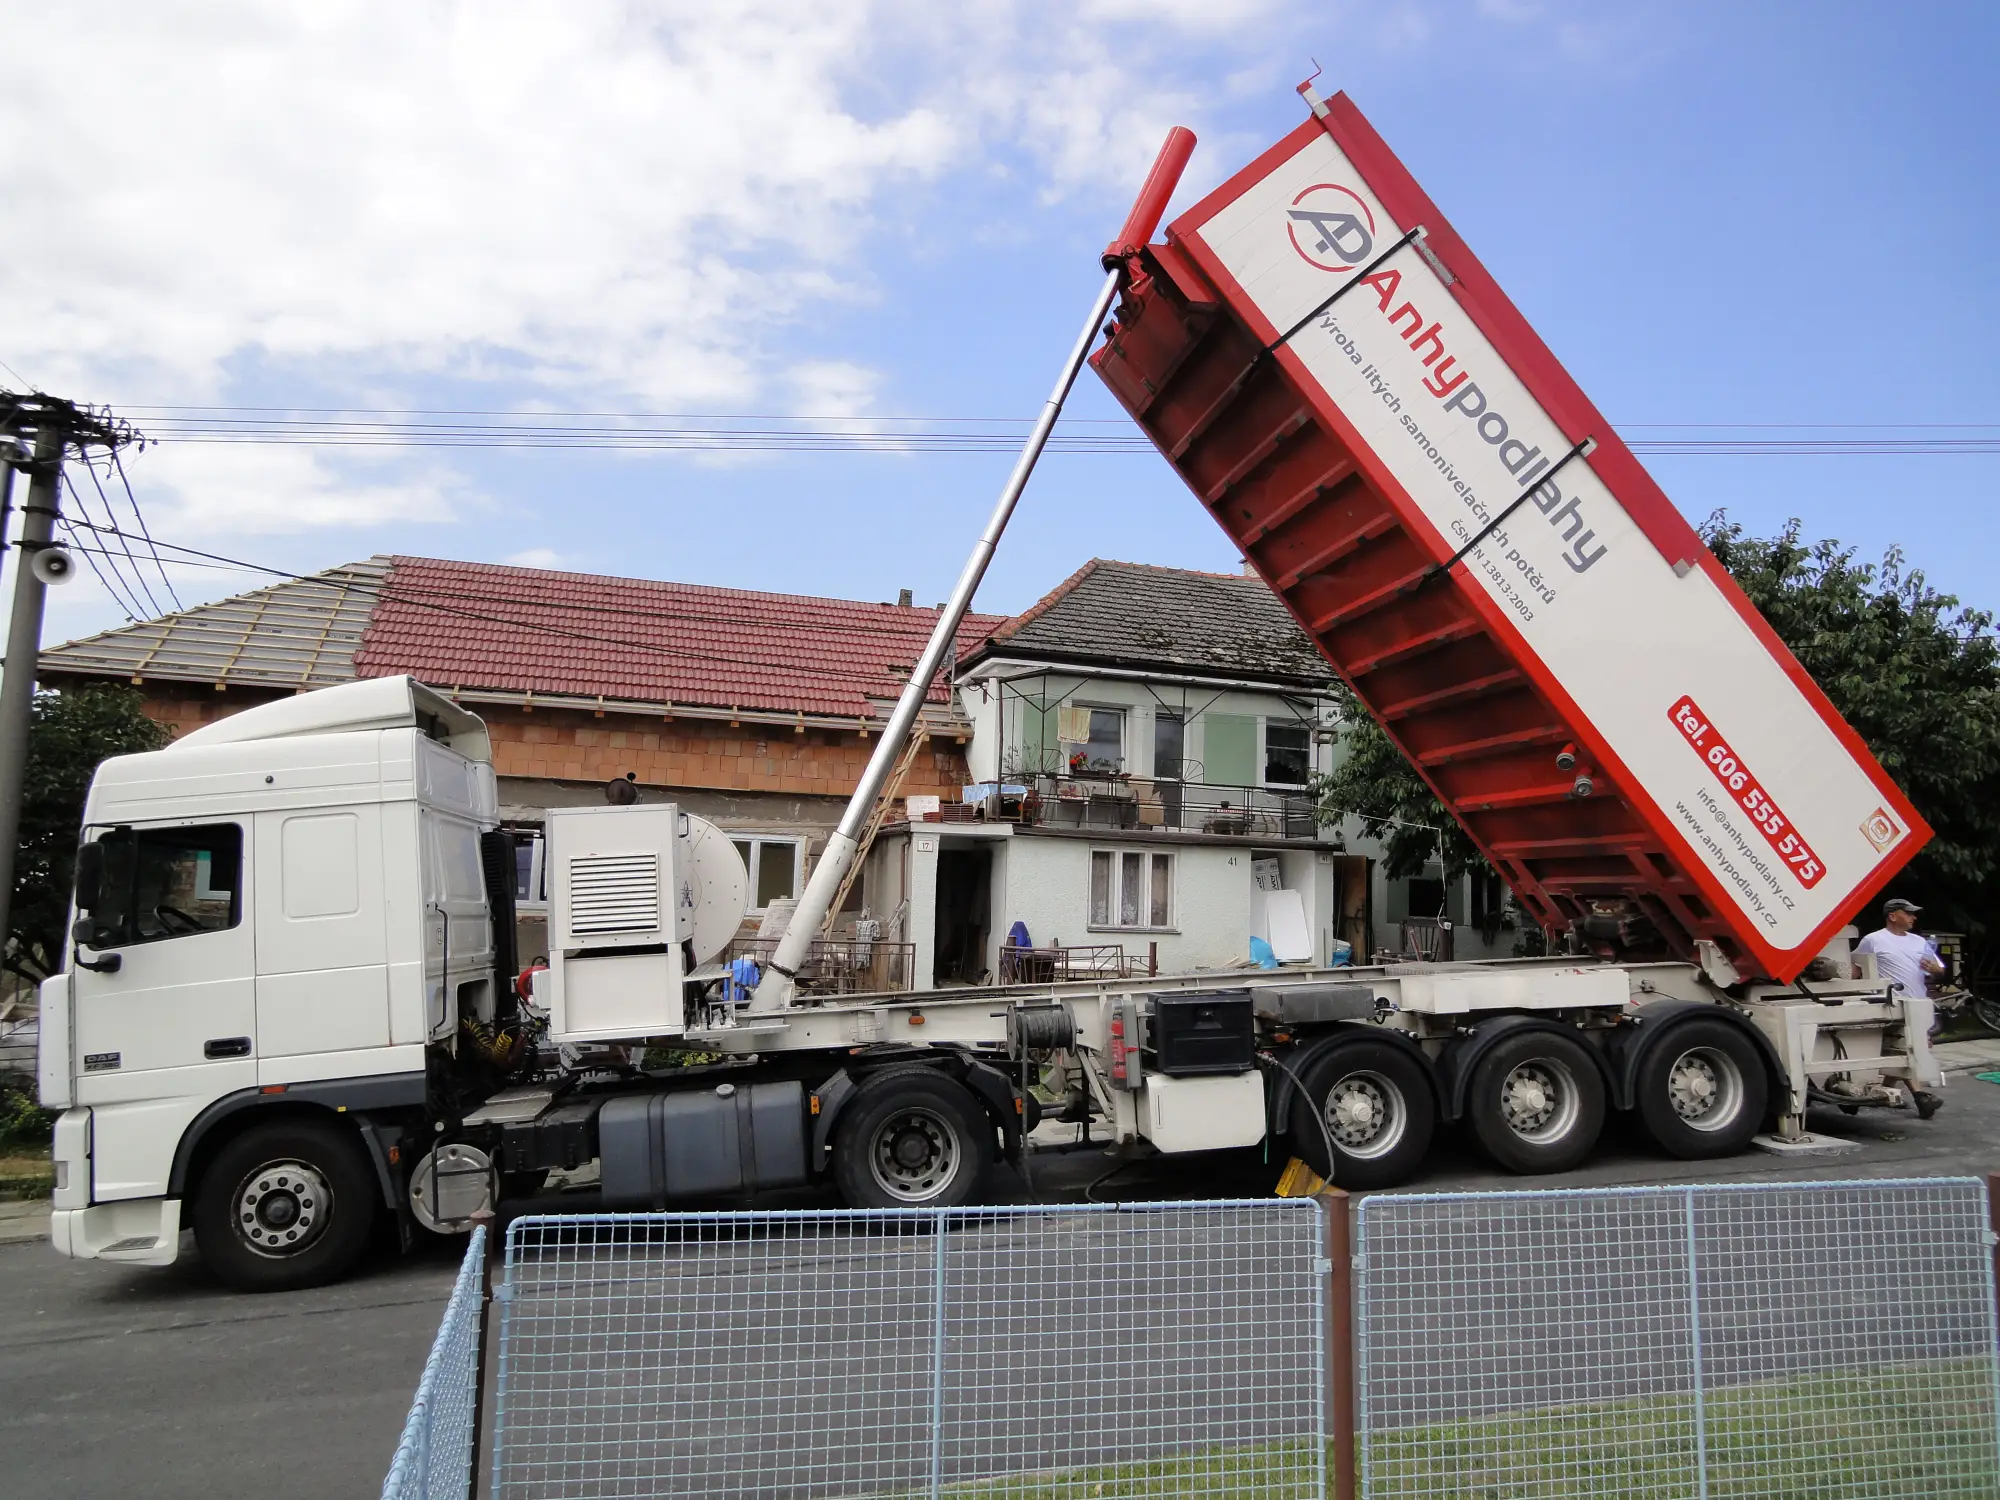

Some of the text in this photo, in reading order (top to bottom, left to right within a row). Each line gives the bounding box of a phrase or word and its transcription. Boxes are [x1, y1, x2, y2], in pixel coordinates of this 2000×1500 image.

[1359, 268, 1608, 574] Anhypodlahy
[1361, 363, 1402, 414] litých
[1399, 414, 1509, 549] samonivelačnch
[1504, 548, 1556, 605] potěrů
[1450, 518, 1472, 544] ČSN
[1481, 559, 1534, 622] 13813:2003
[921, 842, 930, 850] 17
[1676, 704, 1820, 880] tel. 606 555 575
[1696, 787, 1796, 911] info@anhypodlahy.cz
[1227, 857, 1237, 866] 41
[1675, 800, 1778, 928] www.anhypodlahy.cz
[87, 1053, 118, 1062] DAF
